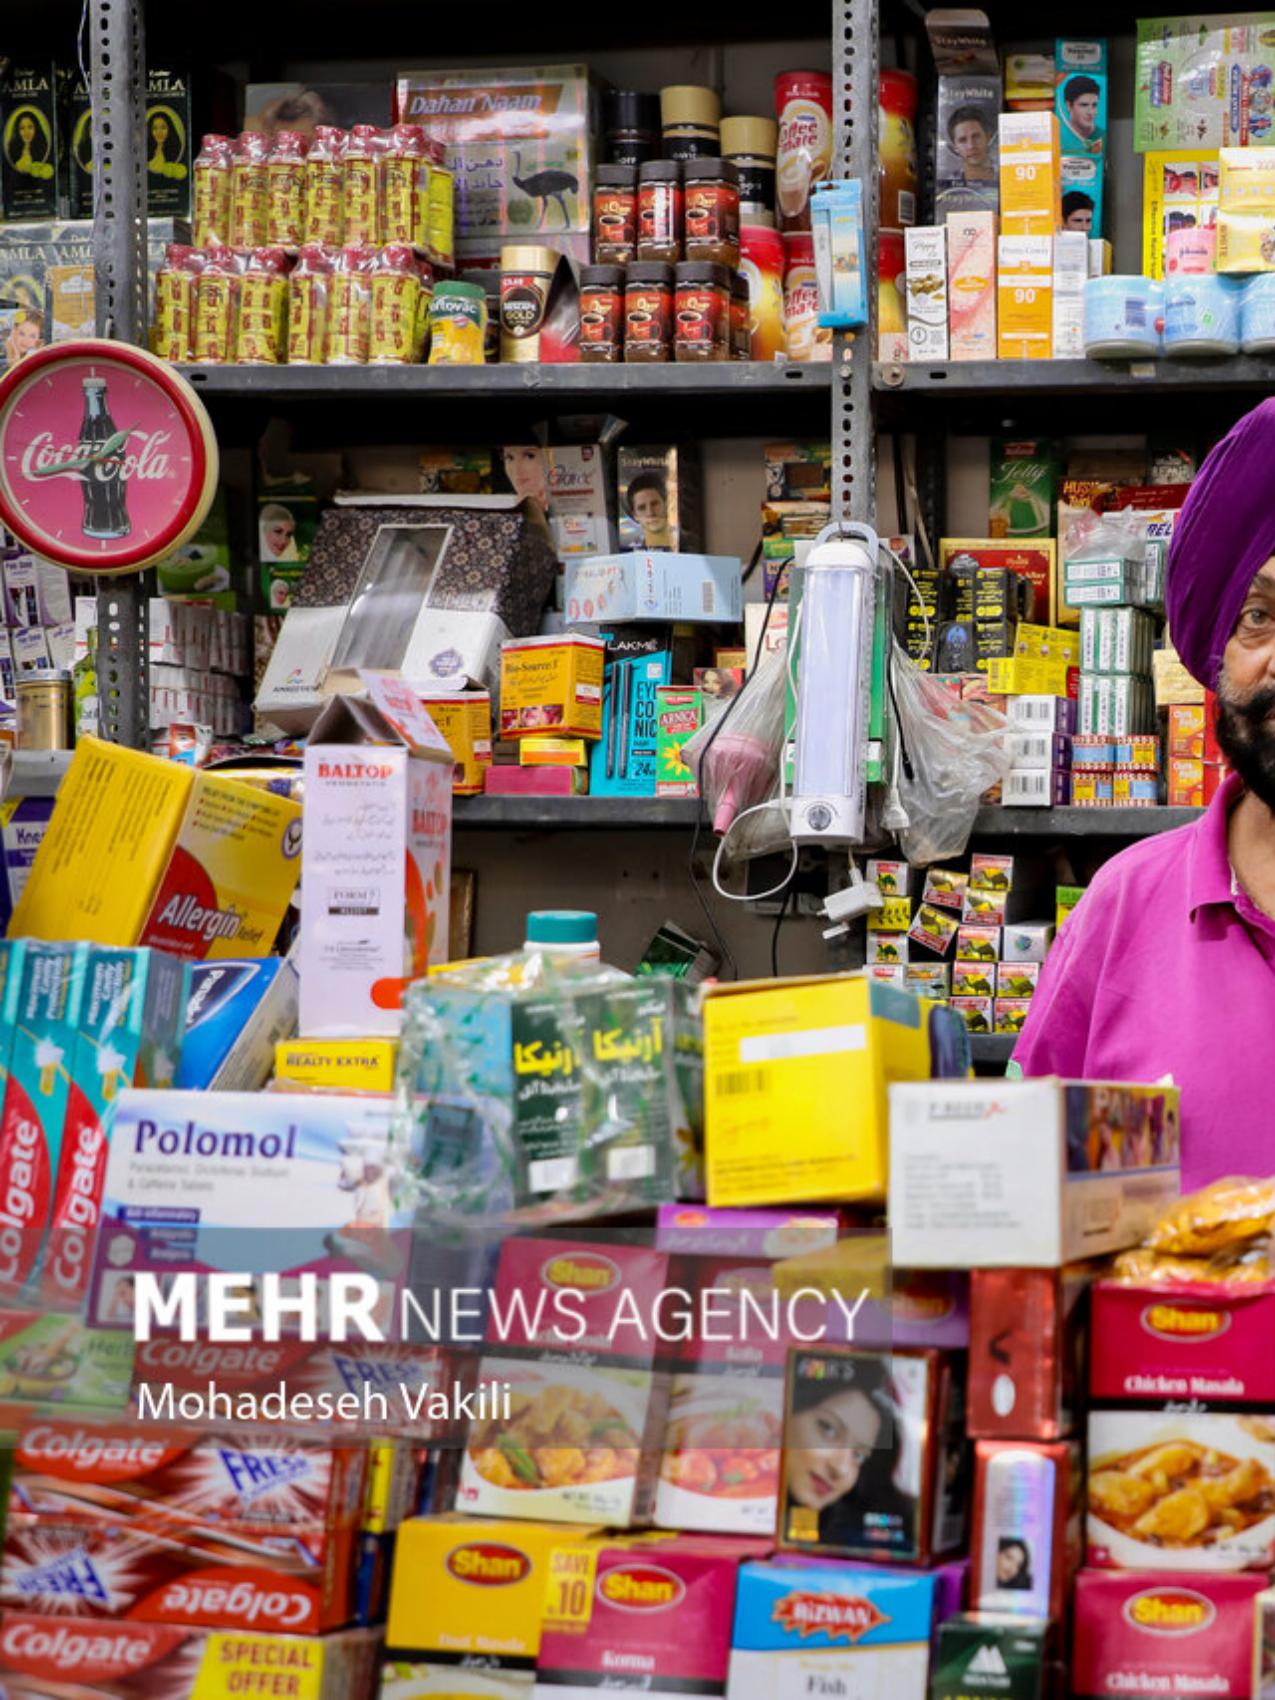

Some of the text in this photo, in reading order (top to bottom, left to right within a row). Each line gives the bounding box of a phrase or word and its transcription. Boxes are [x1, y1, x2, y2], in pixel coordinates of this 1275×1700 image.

[148, 78, 186, 92] MLA
[409, 95, 543, 115] Dahan Naam
[1015, 166, 1037, 181] 90
[1014, 289, 1037, 304] 90
[505, 311, 534, 320] GOLD
[993, 461, 1049, 485] Jelly
[318, 763, 394, 779] BALTOP
[158, 894, 241, 942] Allergin
[336, 1055, 379, 1068] EXTRA
[135, 1118, 298, 1160] Polomol
[0, 1119, 39, 1283] Colgate
[53, 1124, 101, 1290] Colgate
[1149, 1304, 1221, 1333] Shan
[140, 1338, 282, 1373] Colgate
[1124, 1375, 1245, 1395] Chicken Masala
[22, 1426, 165, 1465] Colgate
[453, 1549, 522, 1579] Shan
[559, 1580, 587, 1617] 10
[604, 1573, 674, 1602] Shan
[163, 1582, 312, 1626] Colgate
[1134, 1599, 1203, 1623] Shan
[2, 1623, 152, 1664] Colgate
[218, 1639, 314, 1669] SPECIAL
[226, 1668, 302, 1697] OFFER
[805, 1674, 847, 1697] Fish
[1106, 1672, 1230, 1694] Chicken Masala
